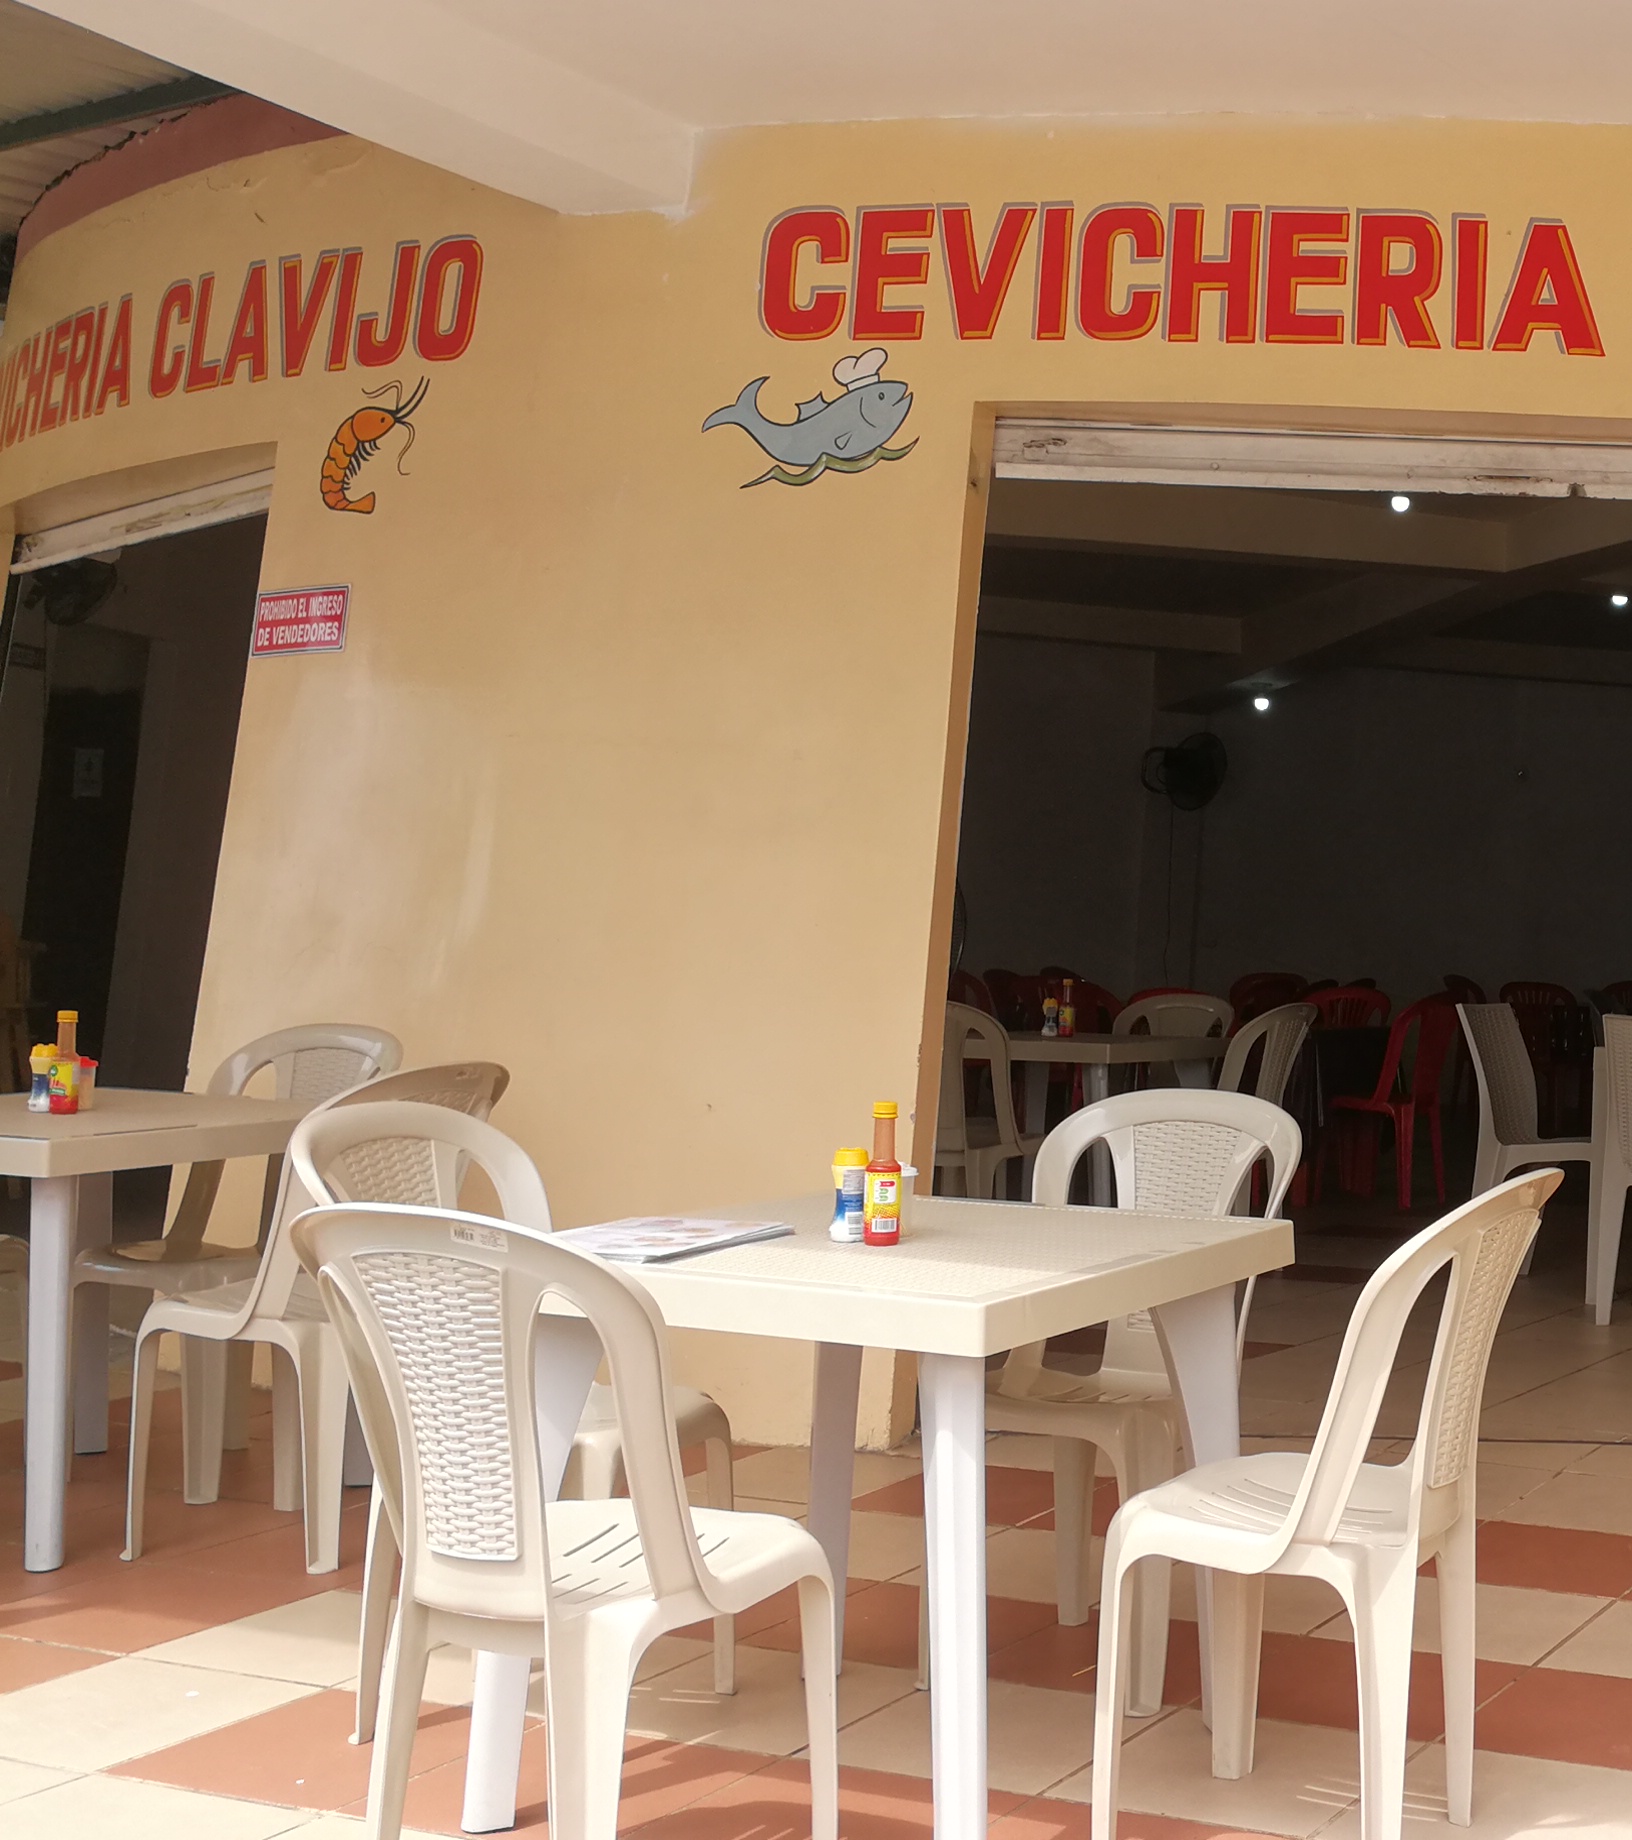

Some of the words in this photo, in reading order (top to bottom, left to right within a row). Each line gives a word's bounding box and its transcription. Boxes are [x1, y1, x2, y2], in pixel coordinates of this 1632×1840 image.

[759, 202, 1605, 357] CEVICHERIA
[0, 293, 132, 452] ICHERIA
[148, 234, 484, 399] CLAVIJO
[257, 627, 272, 647] DE
[272, 621, 339, 645] VENDEDORES
[259, 598, 297, 622] PROHIBIDO
[298, 597, 307, 618] EL
[308, 595, 343, 617] INGRESO
